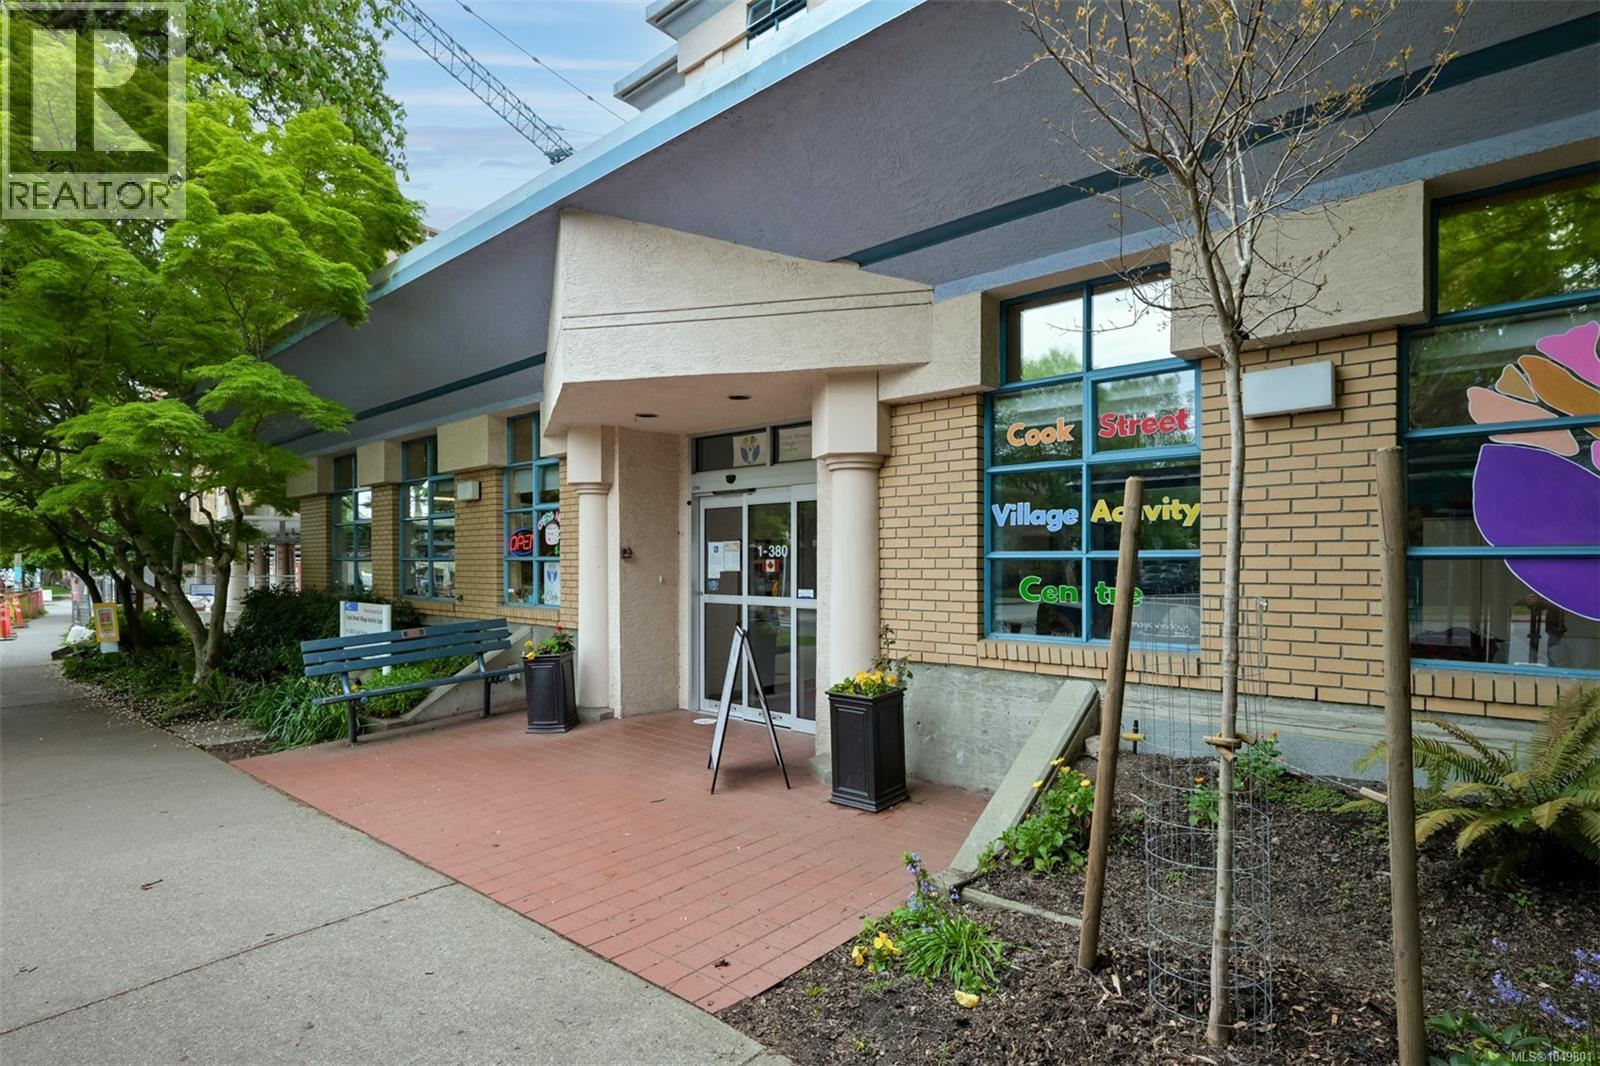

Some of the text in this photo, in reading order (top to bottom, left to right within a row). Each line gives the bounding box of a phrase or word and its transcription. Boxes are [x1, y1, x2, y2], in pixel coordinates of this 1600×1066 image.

[1006, 408, 1190, 447] Cook Street
[991, 496, 1200, 532] Village Acvity
[757, 545, 788, 558] 1-380
